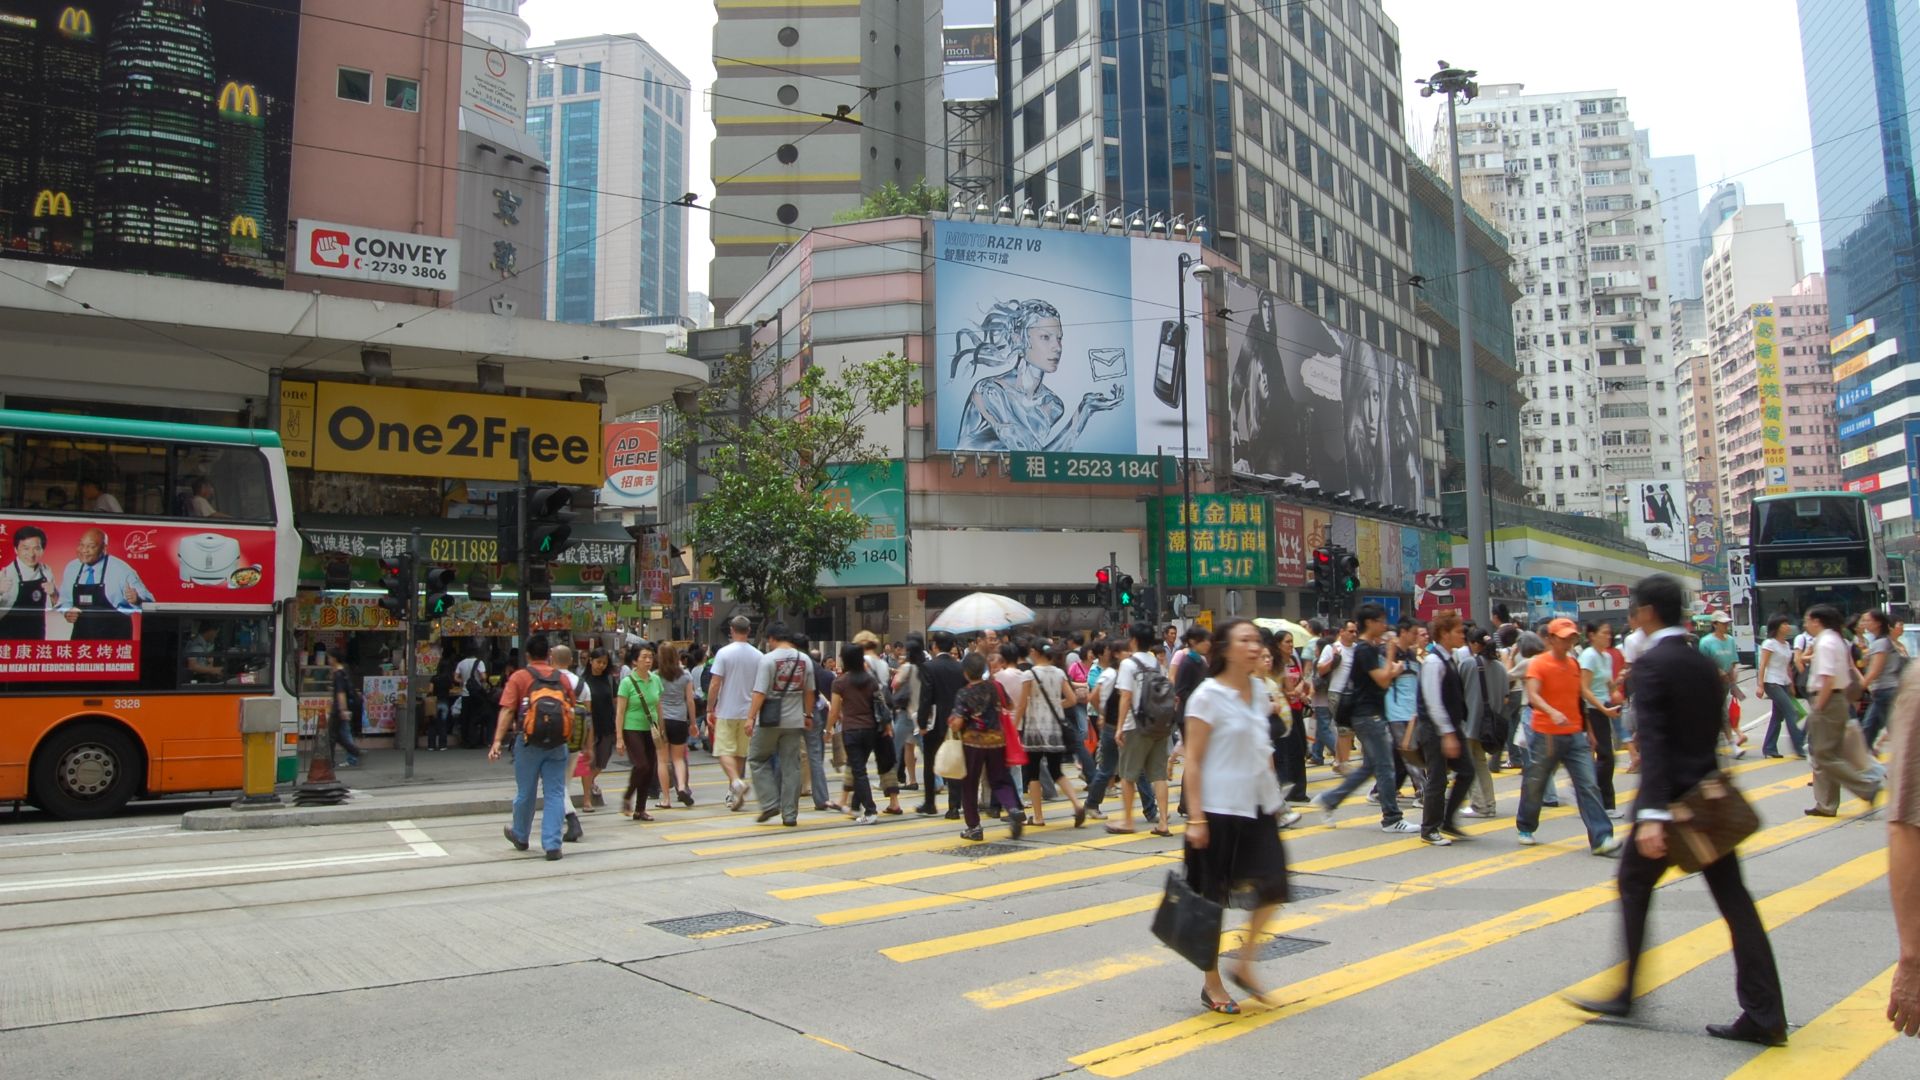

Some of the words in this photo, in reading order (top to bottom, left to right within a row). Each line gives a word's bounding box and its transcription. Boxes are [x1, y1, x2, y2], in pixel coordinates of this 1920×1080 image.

[354, 237, 447, 265] CONVEY
[1026, 239, 1042, 252] V8
[371, 261, 407, 275] 2739
[412, 265, 447, 280] 3806
[282, 391, 308, 400] one
[328, 405, 590, 465] One2Free
[616, 437, 640, 452] AD
[285, 449, 306, 458] ree
[613, 451, 657, 468] HERE
[1067, 459, 1113, 477] 2523
[1118, 461, 1159, 478] 1840
[621, 475, 655, 489] 招廣告
[430, 538, 498, 562] 6211882
[862, 549, 897, 563] 1840
[1199, 558, 1253, 577] 1-3/F
[1822, 563, 1843, 575] 2X
[9, 663, 27, 672] MEAN
[29, 663, 41, 672] FAT
[42, 663, 75, 672] REDUCING
[76, 663, 105, 672] GRILLING
[105, 663, 134, 672] MACHINE
[114, 699, 140, 709] 3328
